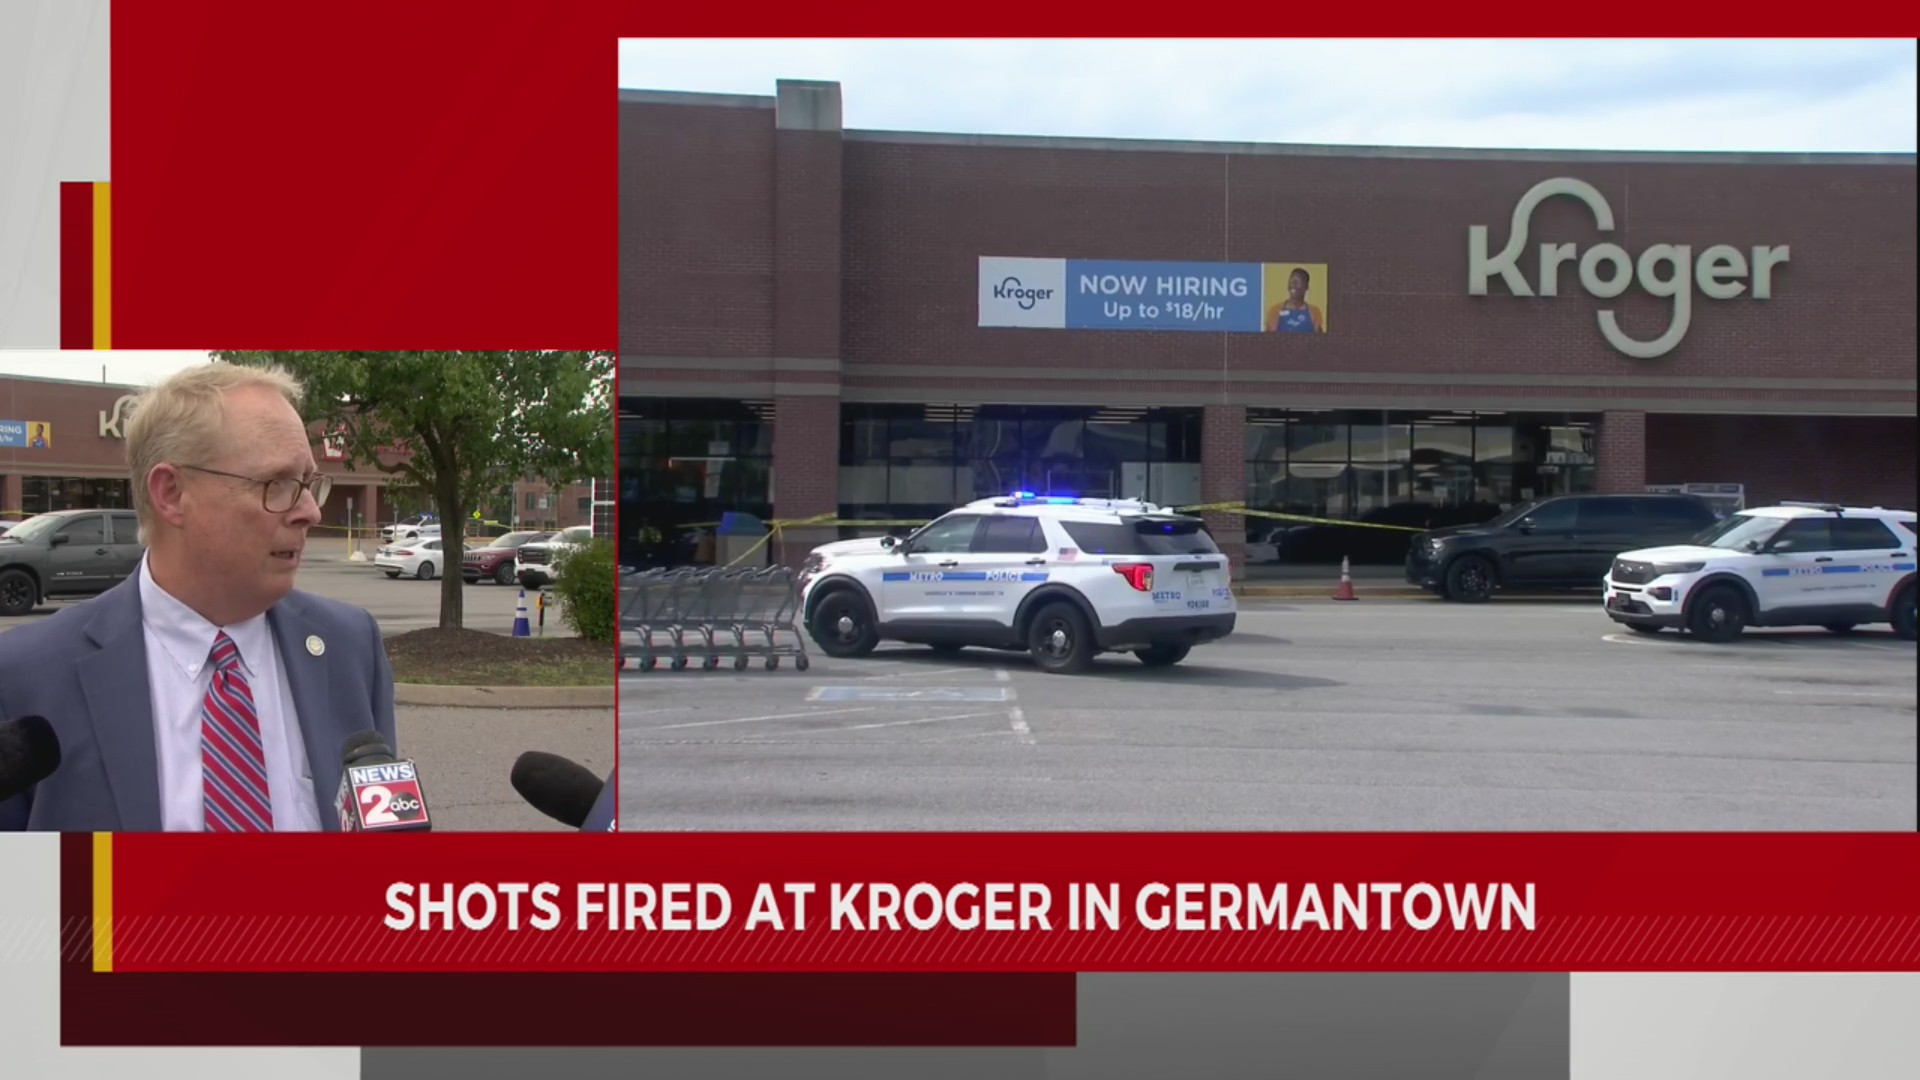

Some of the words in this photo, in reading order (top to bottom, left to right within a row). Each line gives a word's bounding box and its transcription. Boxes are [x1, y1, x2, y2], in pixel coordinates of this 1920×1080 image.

[1468, 177, 1790, 358] Kroger
[993, 276, 1054, 310] Kroger
[1080, 274, 1148, 296] NOW
[1157, 276, 1248, 297] HIRING
[1104, 302, 1132, 319] Up
[1138, 303, 1159, 318] to
[1166, 302, 1224, 321] $18/hr
[910, 571, 943, 581] METRO
[985, 571, 1023, 581] POLICE
[1152, 591, 1181, 600] METRO
[352, 764, 414, 784] NEWS
[360, 785, 400, 825] 2
[390, 798, 420, 812] abc
